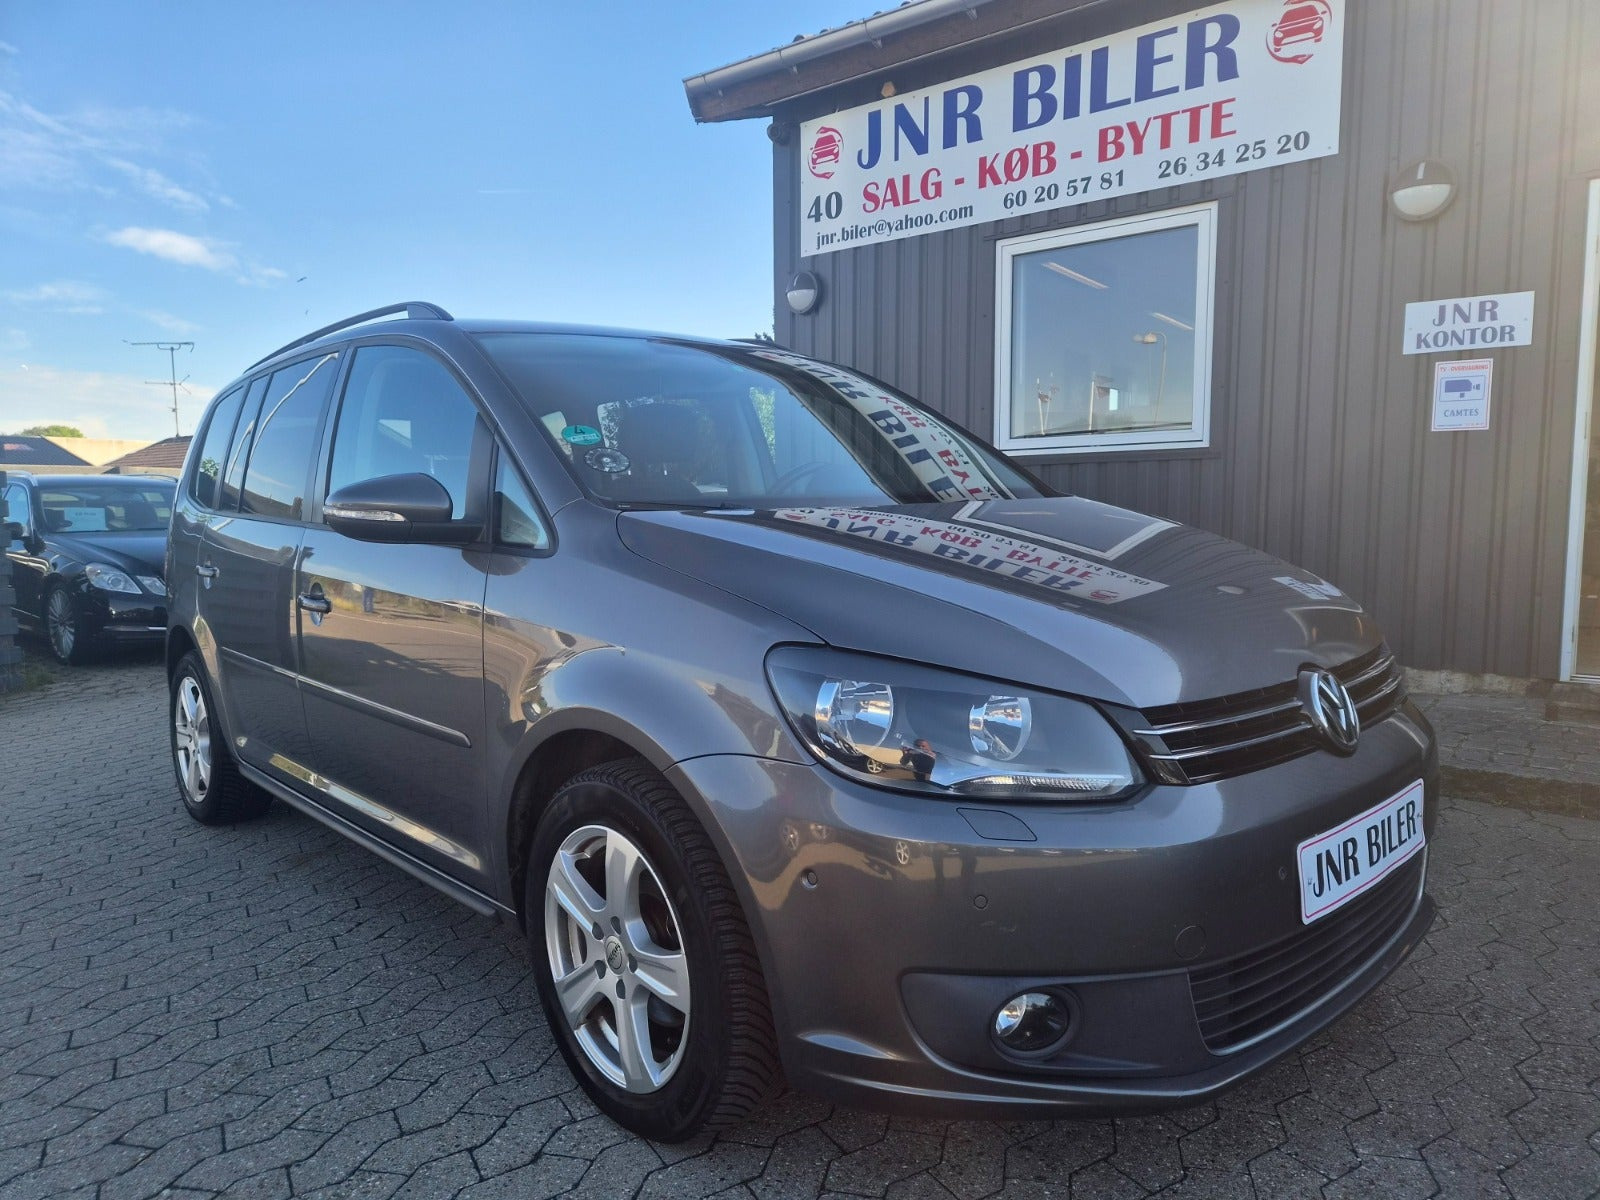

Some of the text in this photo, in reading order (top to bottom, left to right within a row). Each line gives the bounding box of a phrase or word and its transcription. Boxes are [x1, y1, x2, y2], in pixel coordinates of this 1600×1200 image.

[857, 13, 1241, 170] JNR BILER
[862, 167, 943, 214] SALG
[978, 140, 1057, 189] KØB
[1097, 97, 1237, 164] BYTTE
[1002, 130, 1311, 210] 60 20 57 81 26 34 25 20
[807, 191, 843, 223] 40
[816, 205, 974, 250] jnr.biler@yahoo.com
[1432, 299, 1499, 327] JNR
[1415, 325, 1516, 349] KONTOR
[1443, 408, 1480, 418] CAMTES
[1313, 799, 1417, 898] JNR BILER
